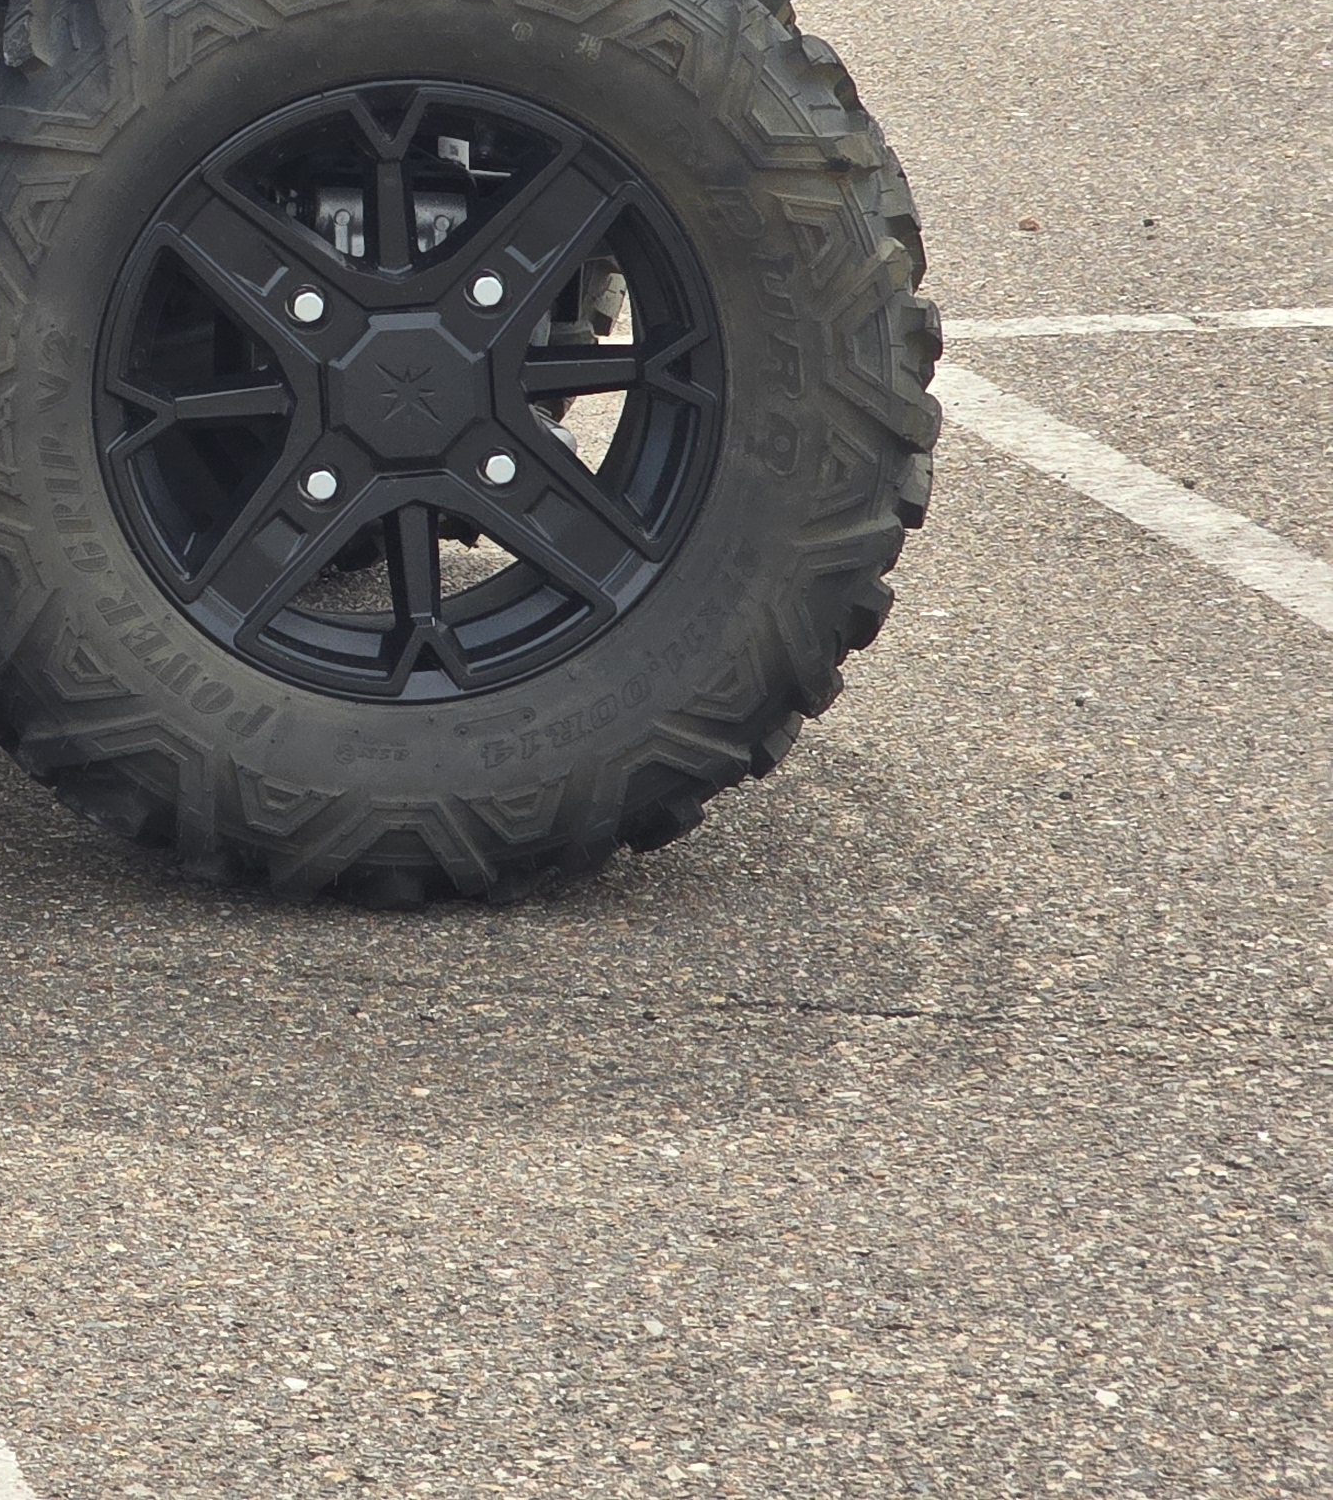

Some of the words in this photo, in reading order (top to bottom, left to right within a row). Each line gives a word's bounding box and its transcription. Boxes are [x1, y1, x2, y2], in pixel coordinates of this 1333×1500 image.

[36, 325, 78, 413] V2
[34, 433, 114, 580] GRIP
[94, 588, 274, 743] POWER
